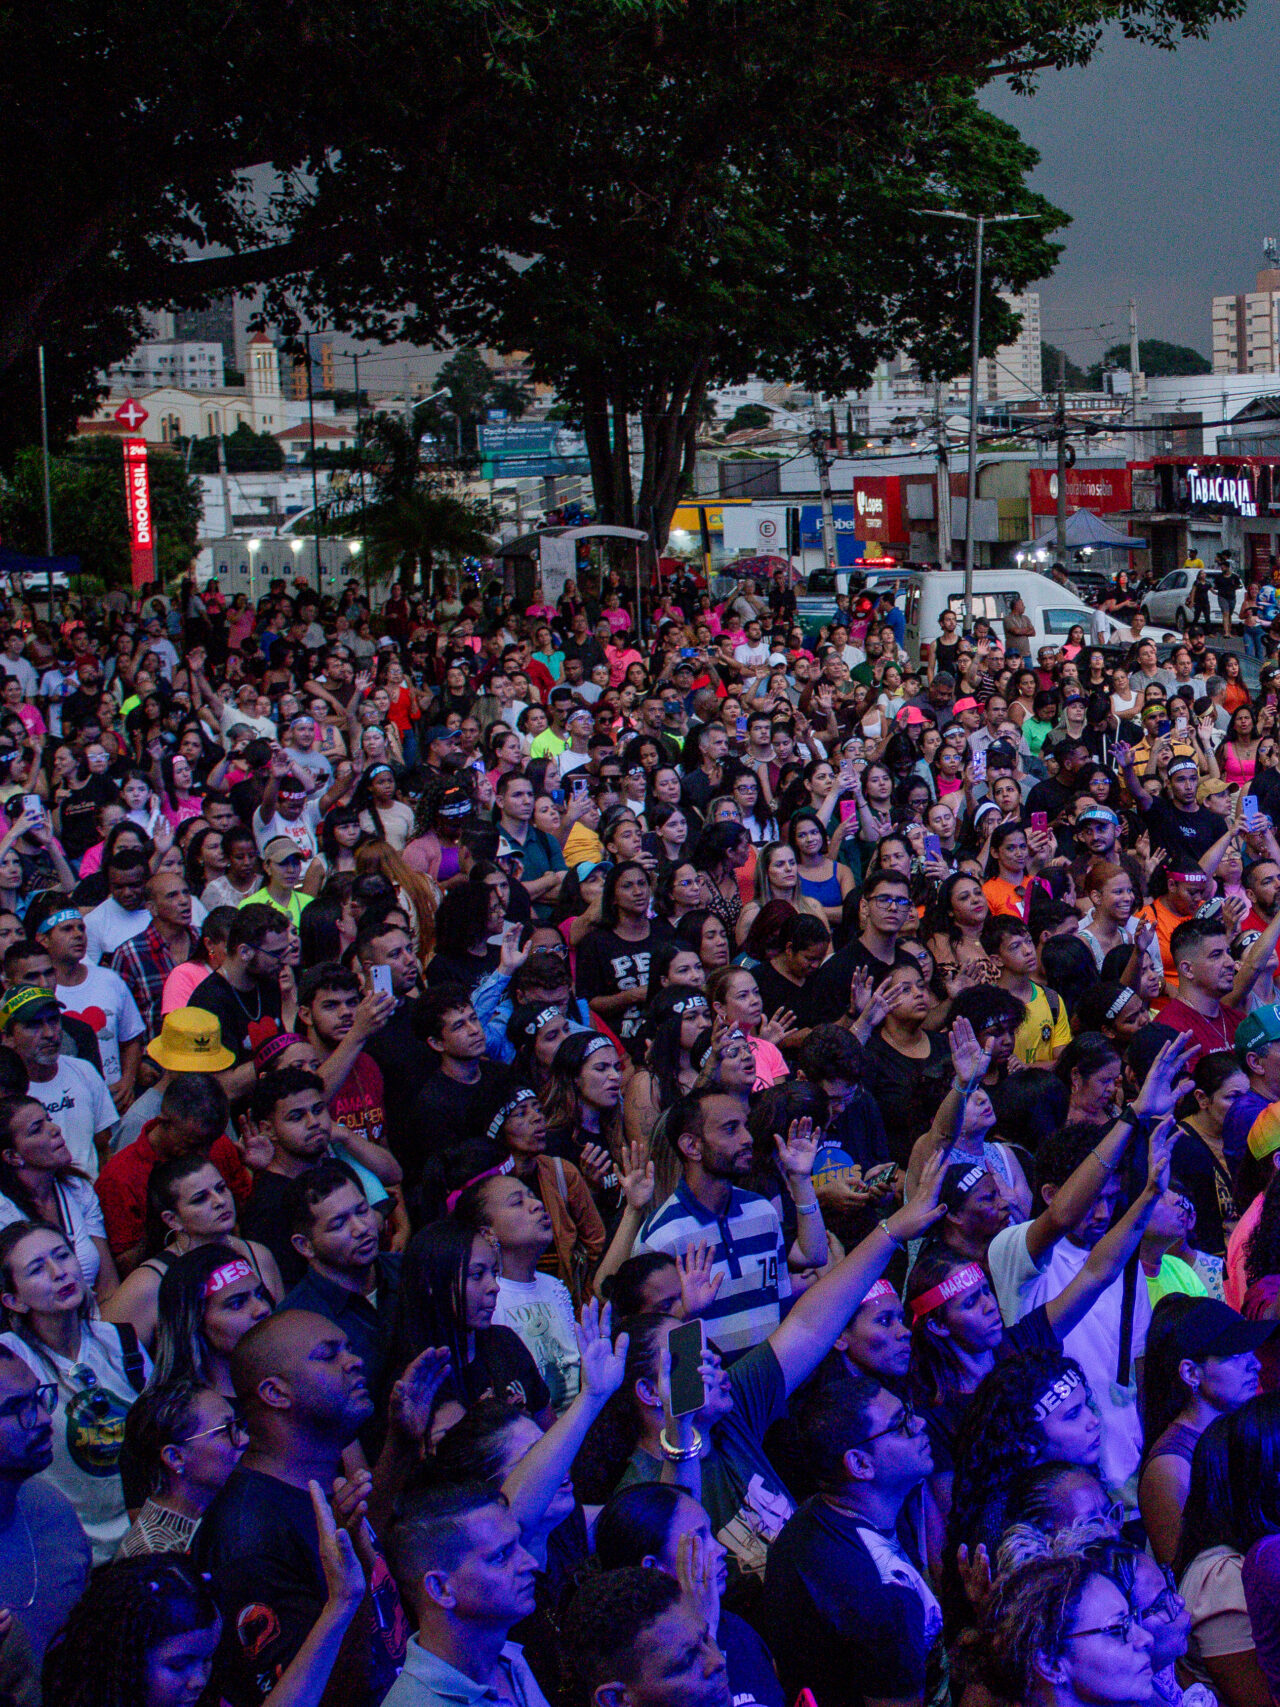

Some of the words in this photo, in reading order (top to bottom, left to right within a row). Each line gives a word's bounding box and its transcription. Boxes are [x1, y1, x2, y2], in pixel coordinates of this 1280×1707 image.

[134, 463, 150, 543] DROGASIL
[1187, 469, 1250, 509] TABACARIA
[1241, 501, 1257, 516] BAR
